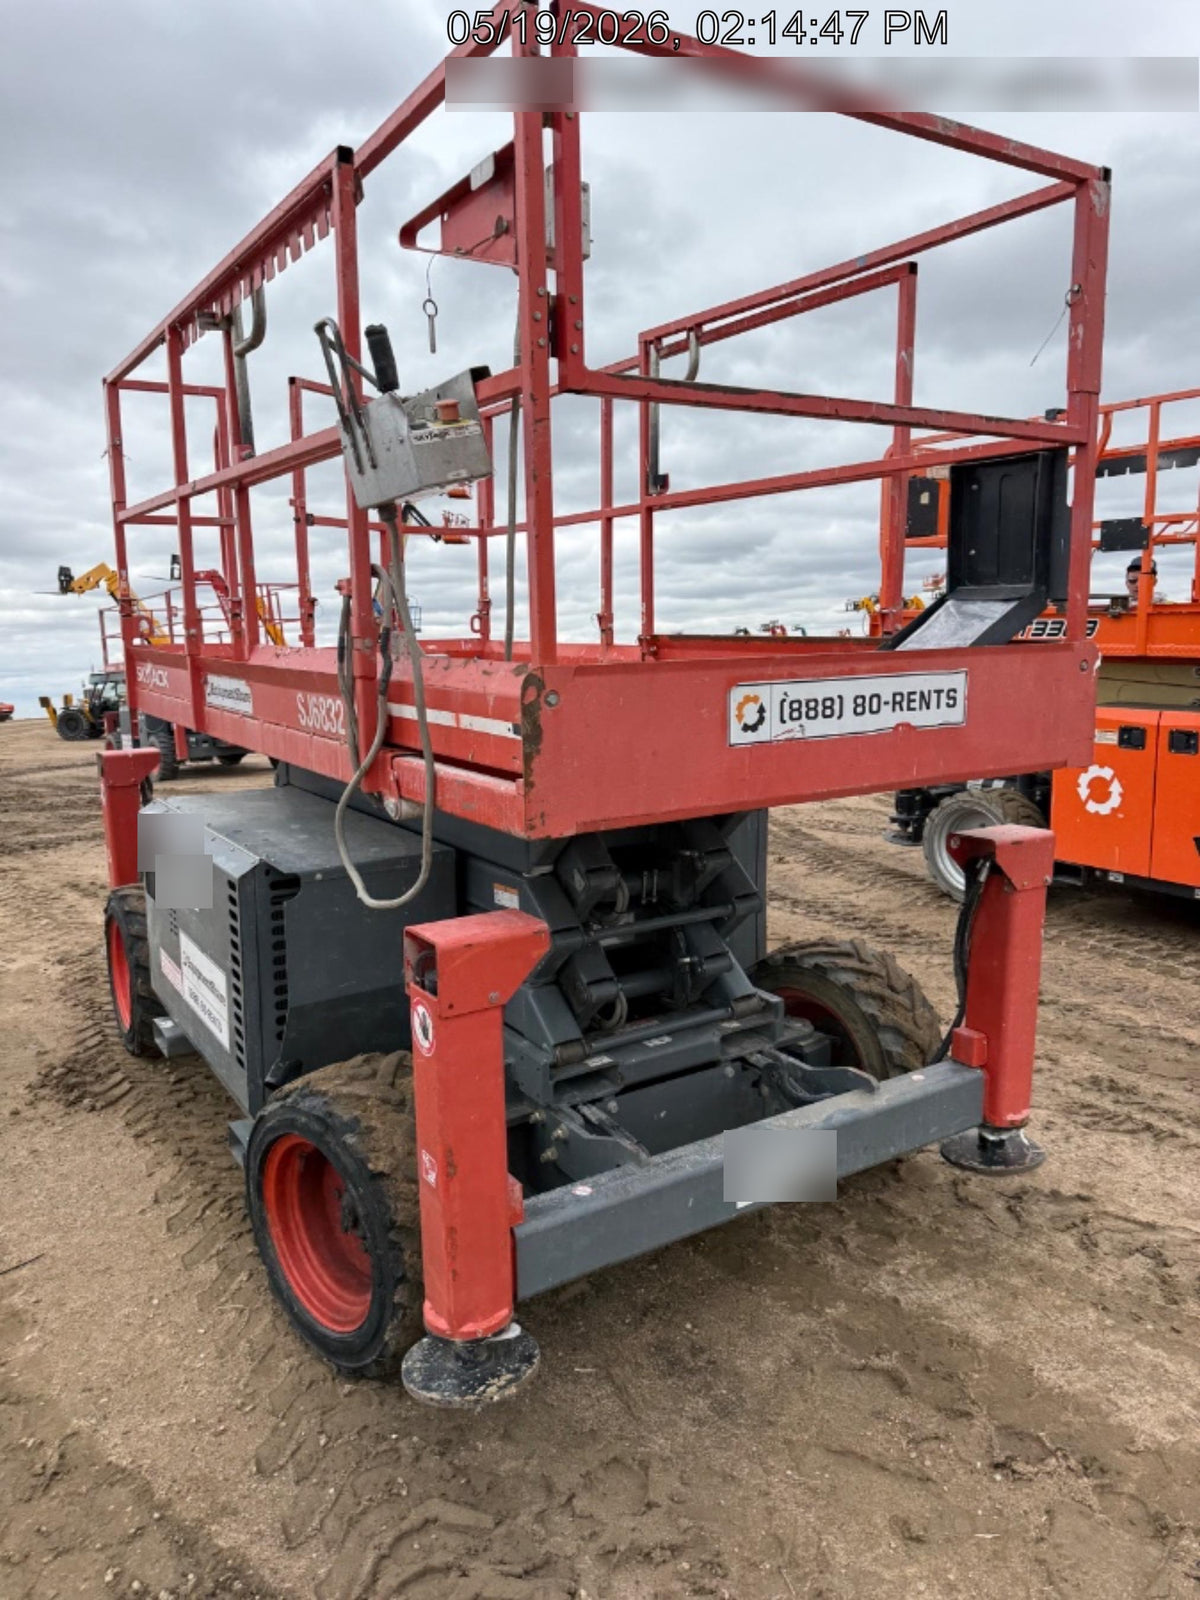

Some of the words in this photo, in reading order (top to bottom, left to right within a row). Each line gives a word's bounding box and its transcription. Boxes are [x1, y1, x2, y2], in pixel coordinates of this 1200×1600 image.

[297, 692, 346, 735] SJ6832
[780, 694, 844, 725] (888)
[852, 687, 958, 717] 80-RENTS
